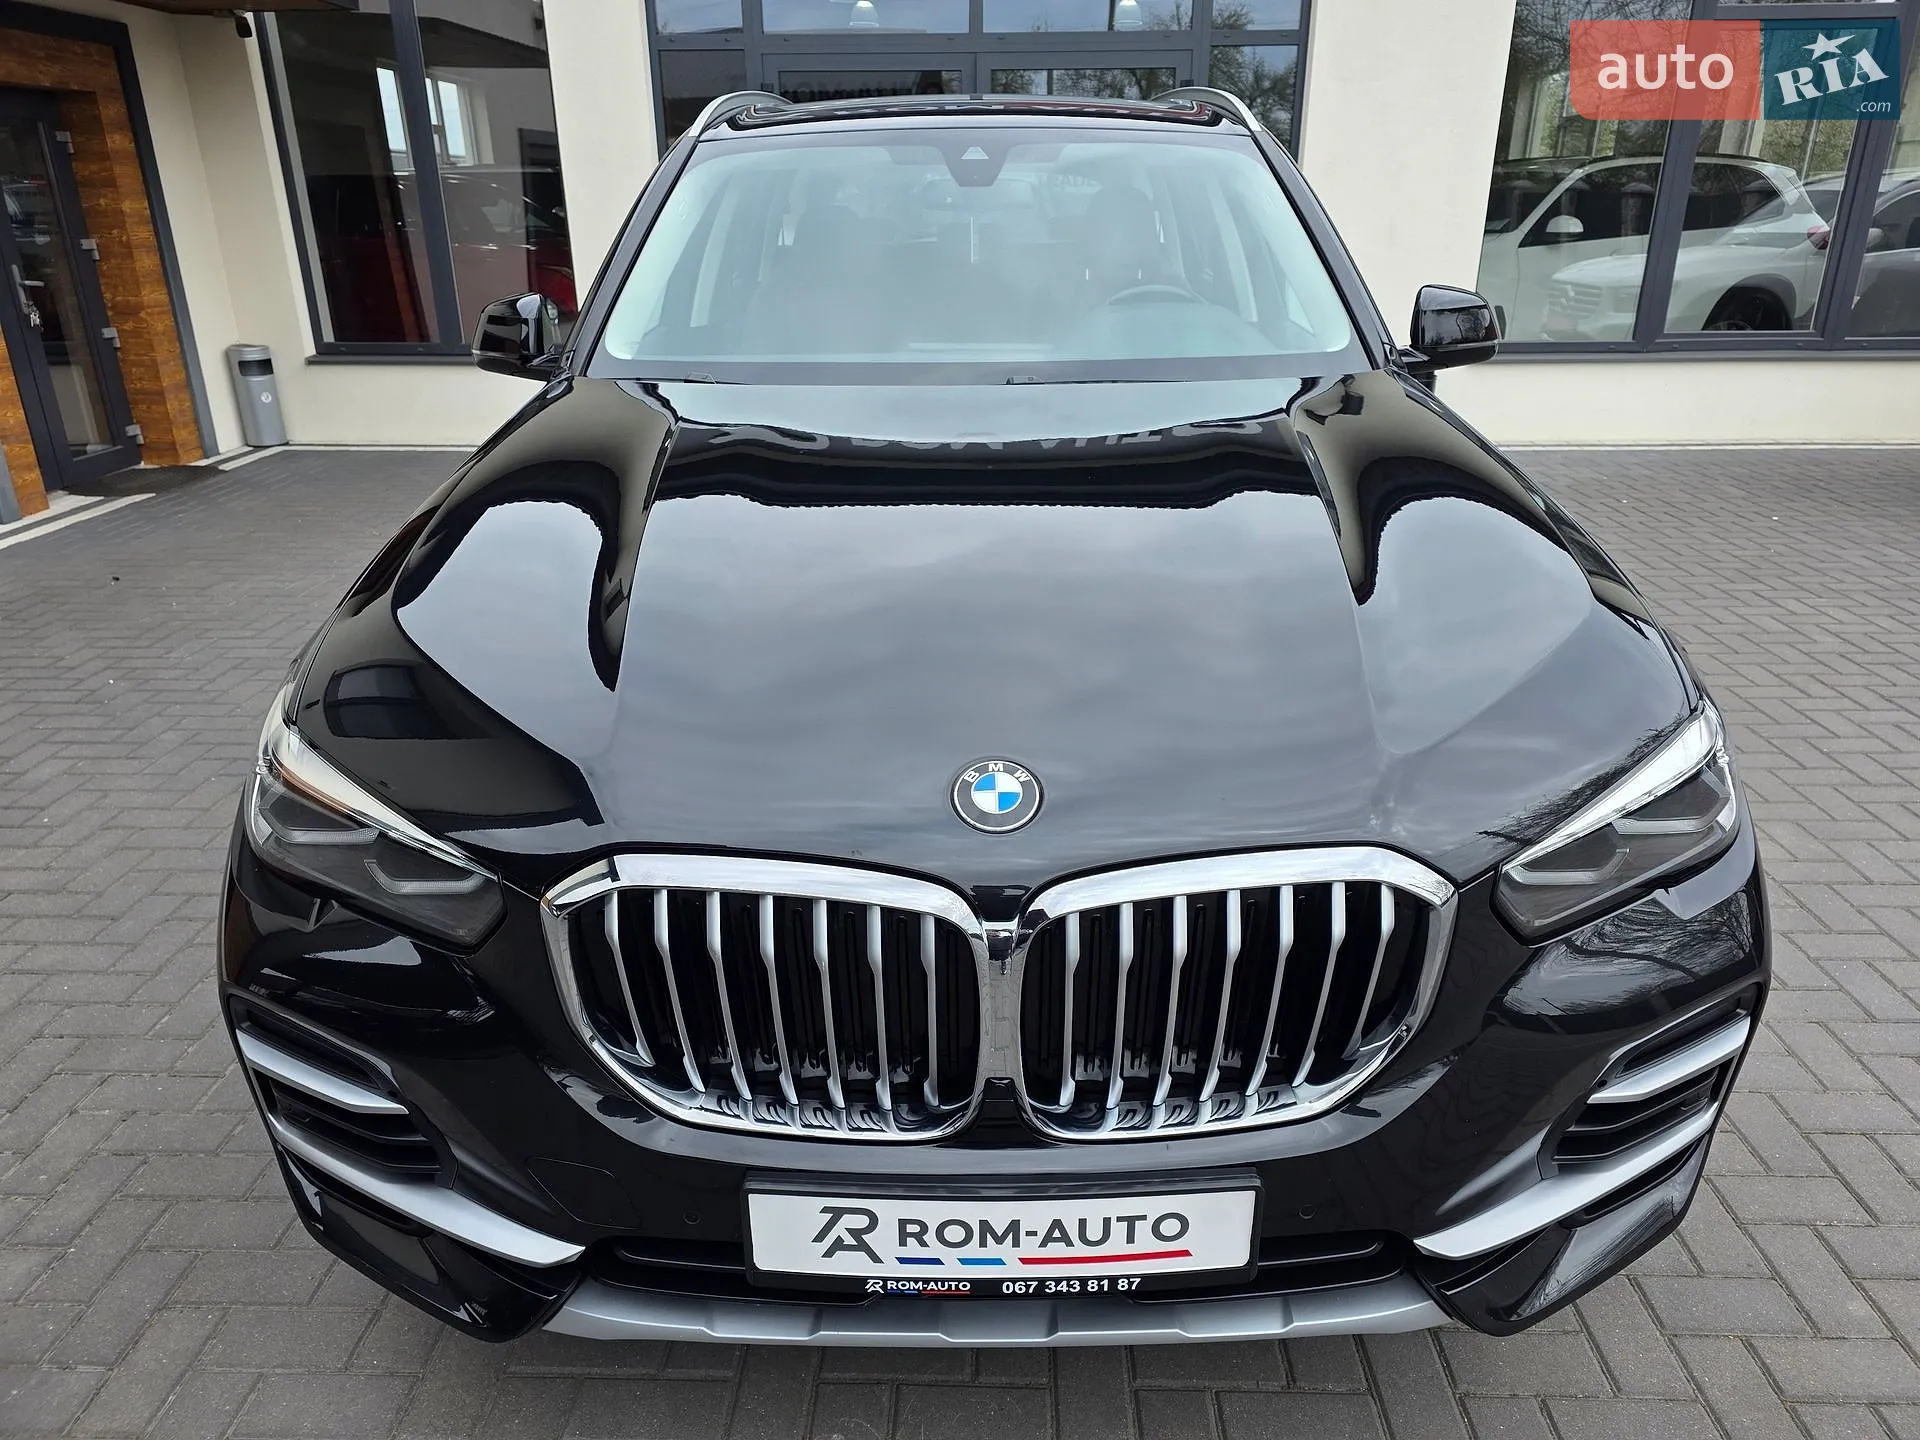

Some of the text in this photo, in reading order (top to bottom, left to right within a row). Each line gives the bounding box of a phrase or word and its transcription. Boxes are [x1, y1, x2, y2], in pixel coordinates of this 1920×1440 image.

[963, 762, 1031, 783] BMW
[897, 1212, 1190, 1249] ROM-AUTO
[887, 1280, 971, 1291] ROM-AUTO
[1002, 1277, 1142, 1294] 067 343 81 87
